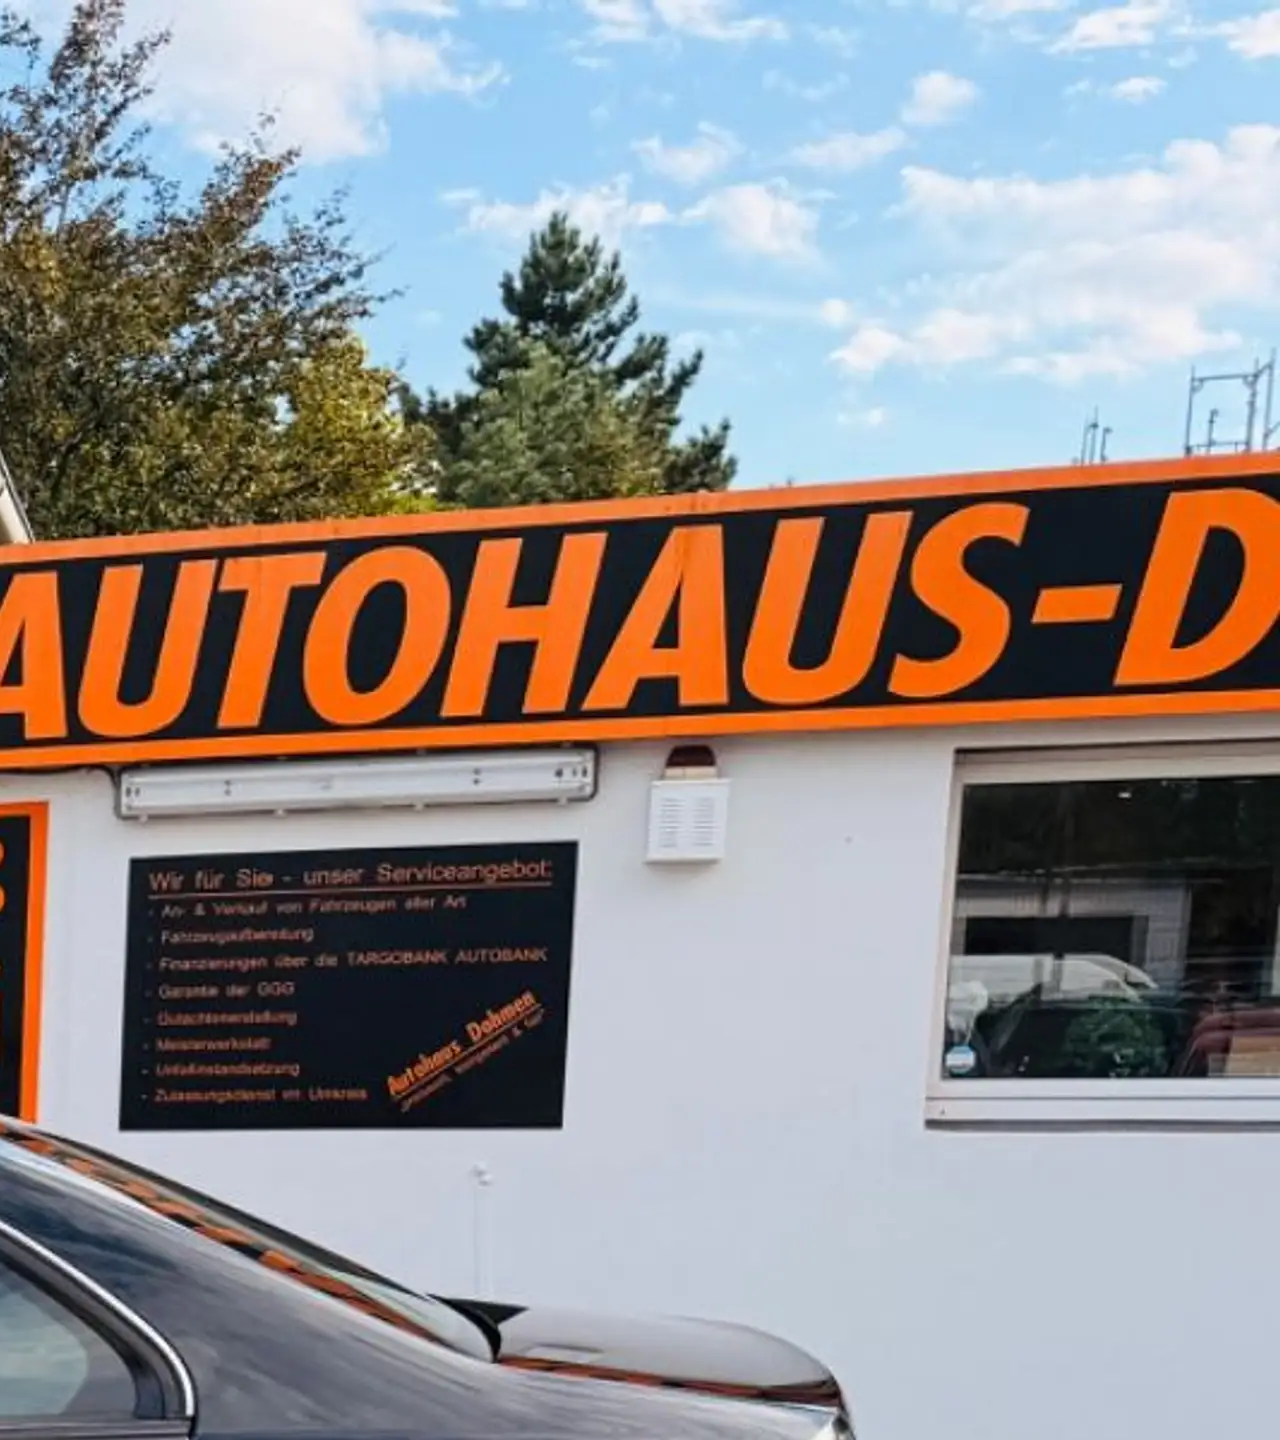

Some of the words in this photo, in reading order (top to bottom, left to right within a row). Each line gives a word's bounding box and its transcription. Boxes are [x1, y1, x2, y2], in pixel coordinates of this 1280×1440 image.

[149, 870, 184, 890] Wir
[195, 869, 226, 889] für
[236, 867, 275, 888] Sie
[303, 867, 364, 886] unser
[377, 859, 553, 884] Serviceangebot:
[276, 902, 303, 915] von
[309, 897, 396, 914] Fahrzeugen
[347, 949, 449, 967] TARGOBANK
[454, 947, 549, 964] AUTOBANK
